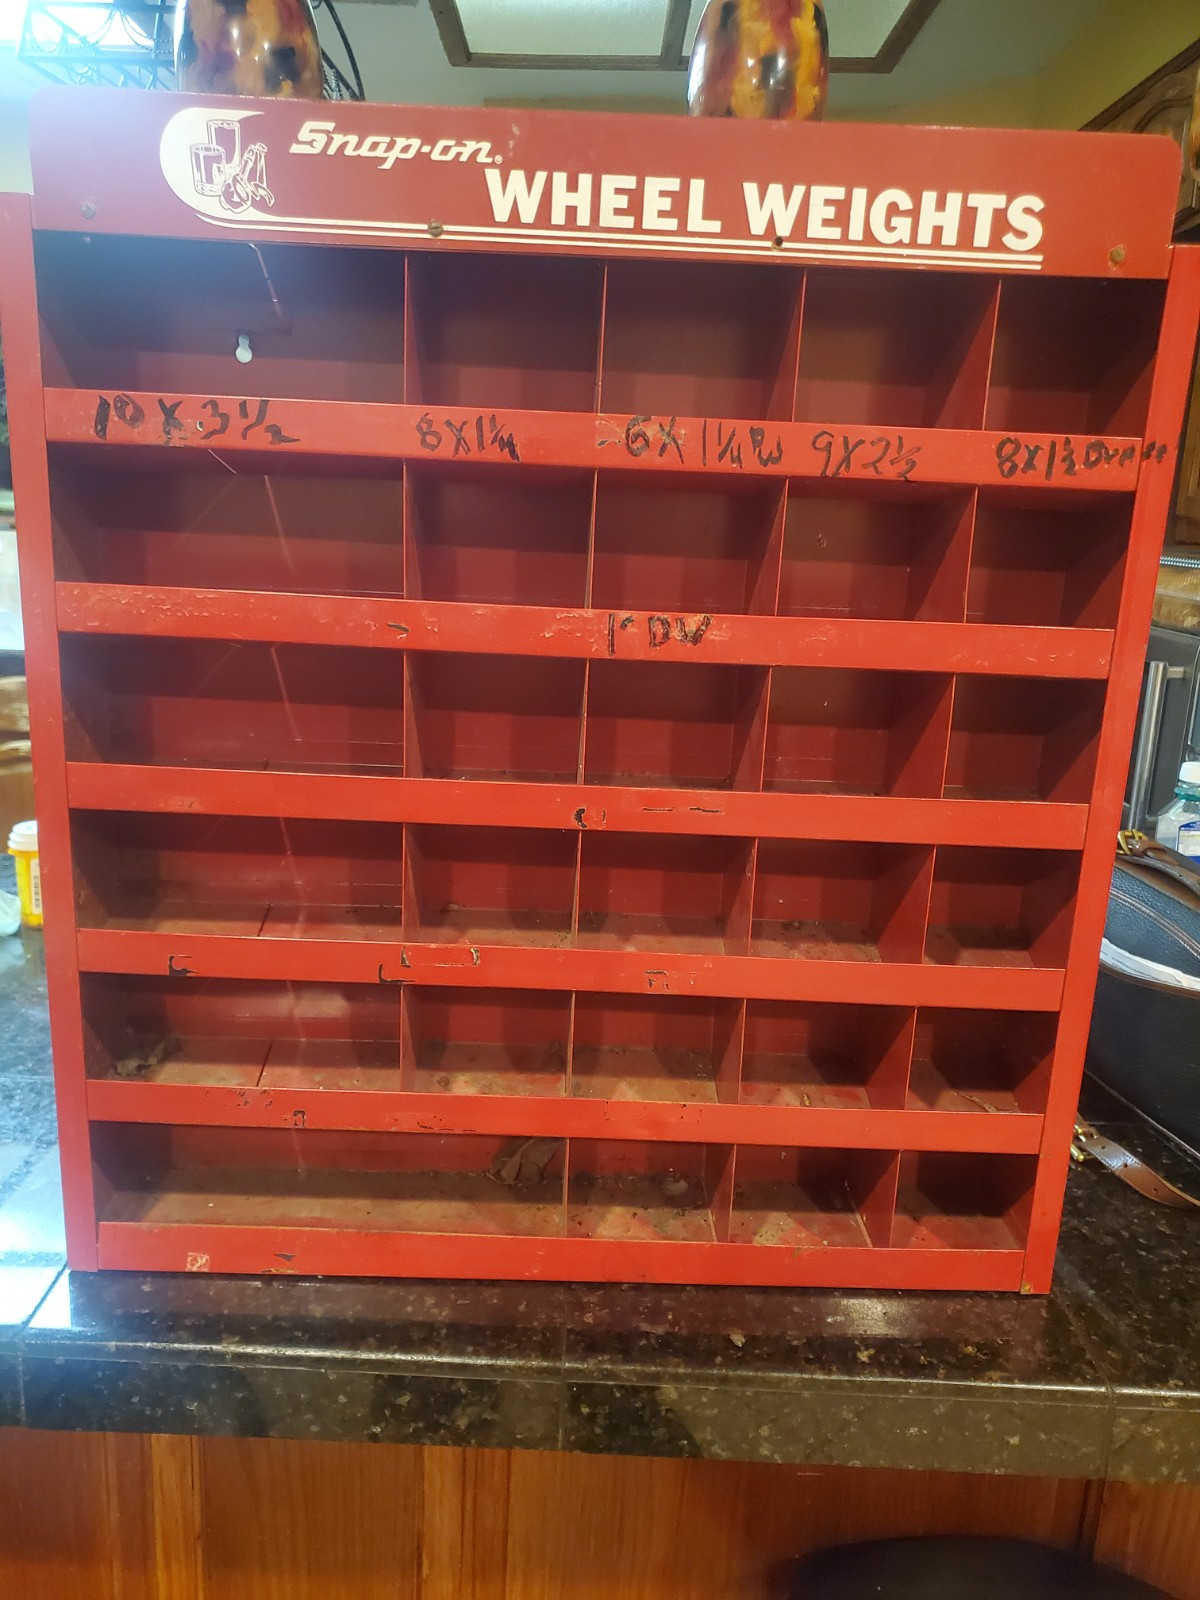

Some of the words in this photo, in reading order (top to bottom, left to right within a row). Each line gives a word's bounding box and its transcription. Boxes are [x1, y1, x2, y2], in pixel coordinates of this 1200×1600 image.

[484, 168, 722, 234] WHEEL
[742, 182, 1046, 252] WEIGHTS
[94, 393, 145, 441] 10
